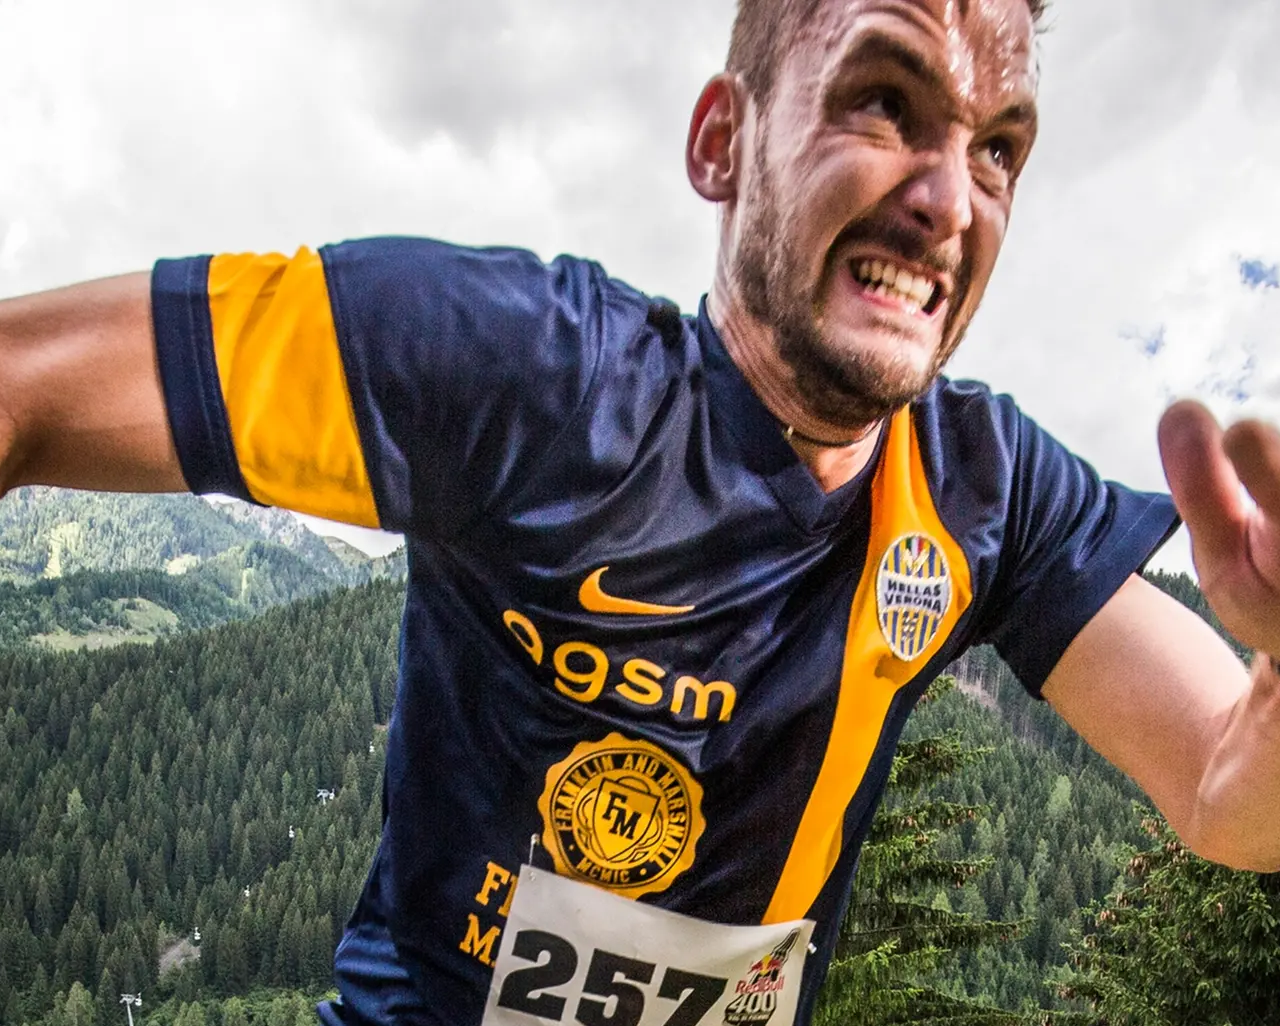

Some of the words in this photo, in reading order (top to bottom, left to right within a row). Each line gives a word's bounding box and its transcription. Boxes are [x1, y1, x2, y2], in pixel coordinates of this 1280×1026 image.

[887, 580, 942, 597] HELLAS
[884, 594, 942, 613] VERONA
[555, 754, 615, 831] FRANKLIN
[622, 754, 659, 777] AND
[652, 771, 687, 870] MARSHALL
[728, 992, 776, 1014] 400
